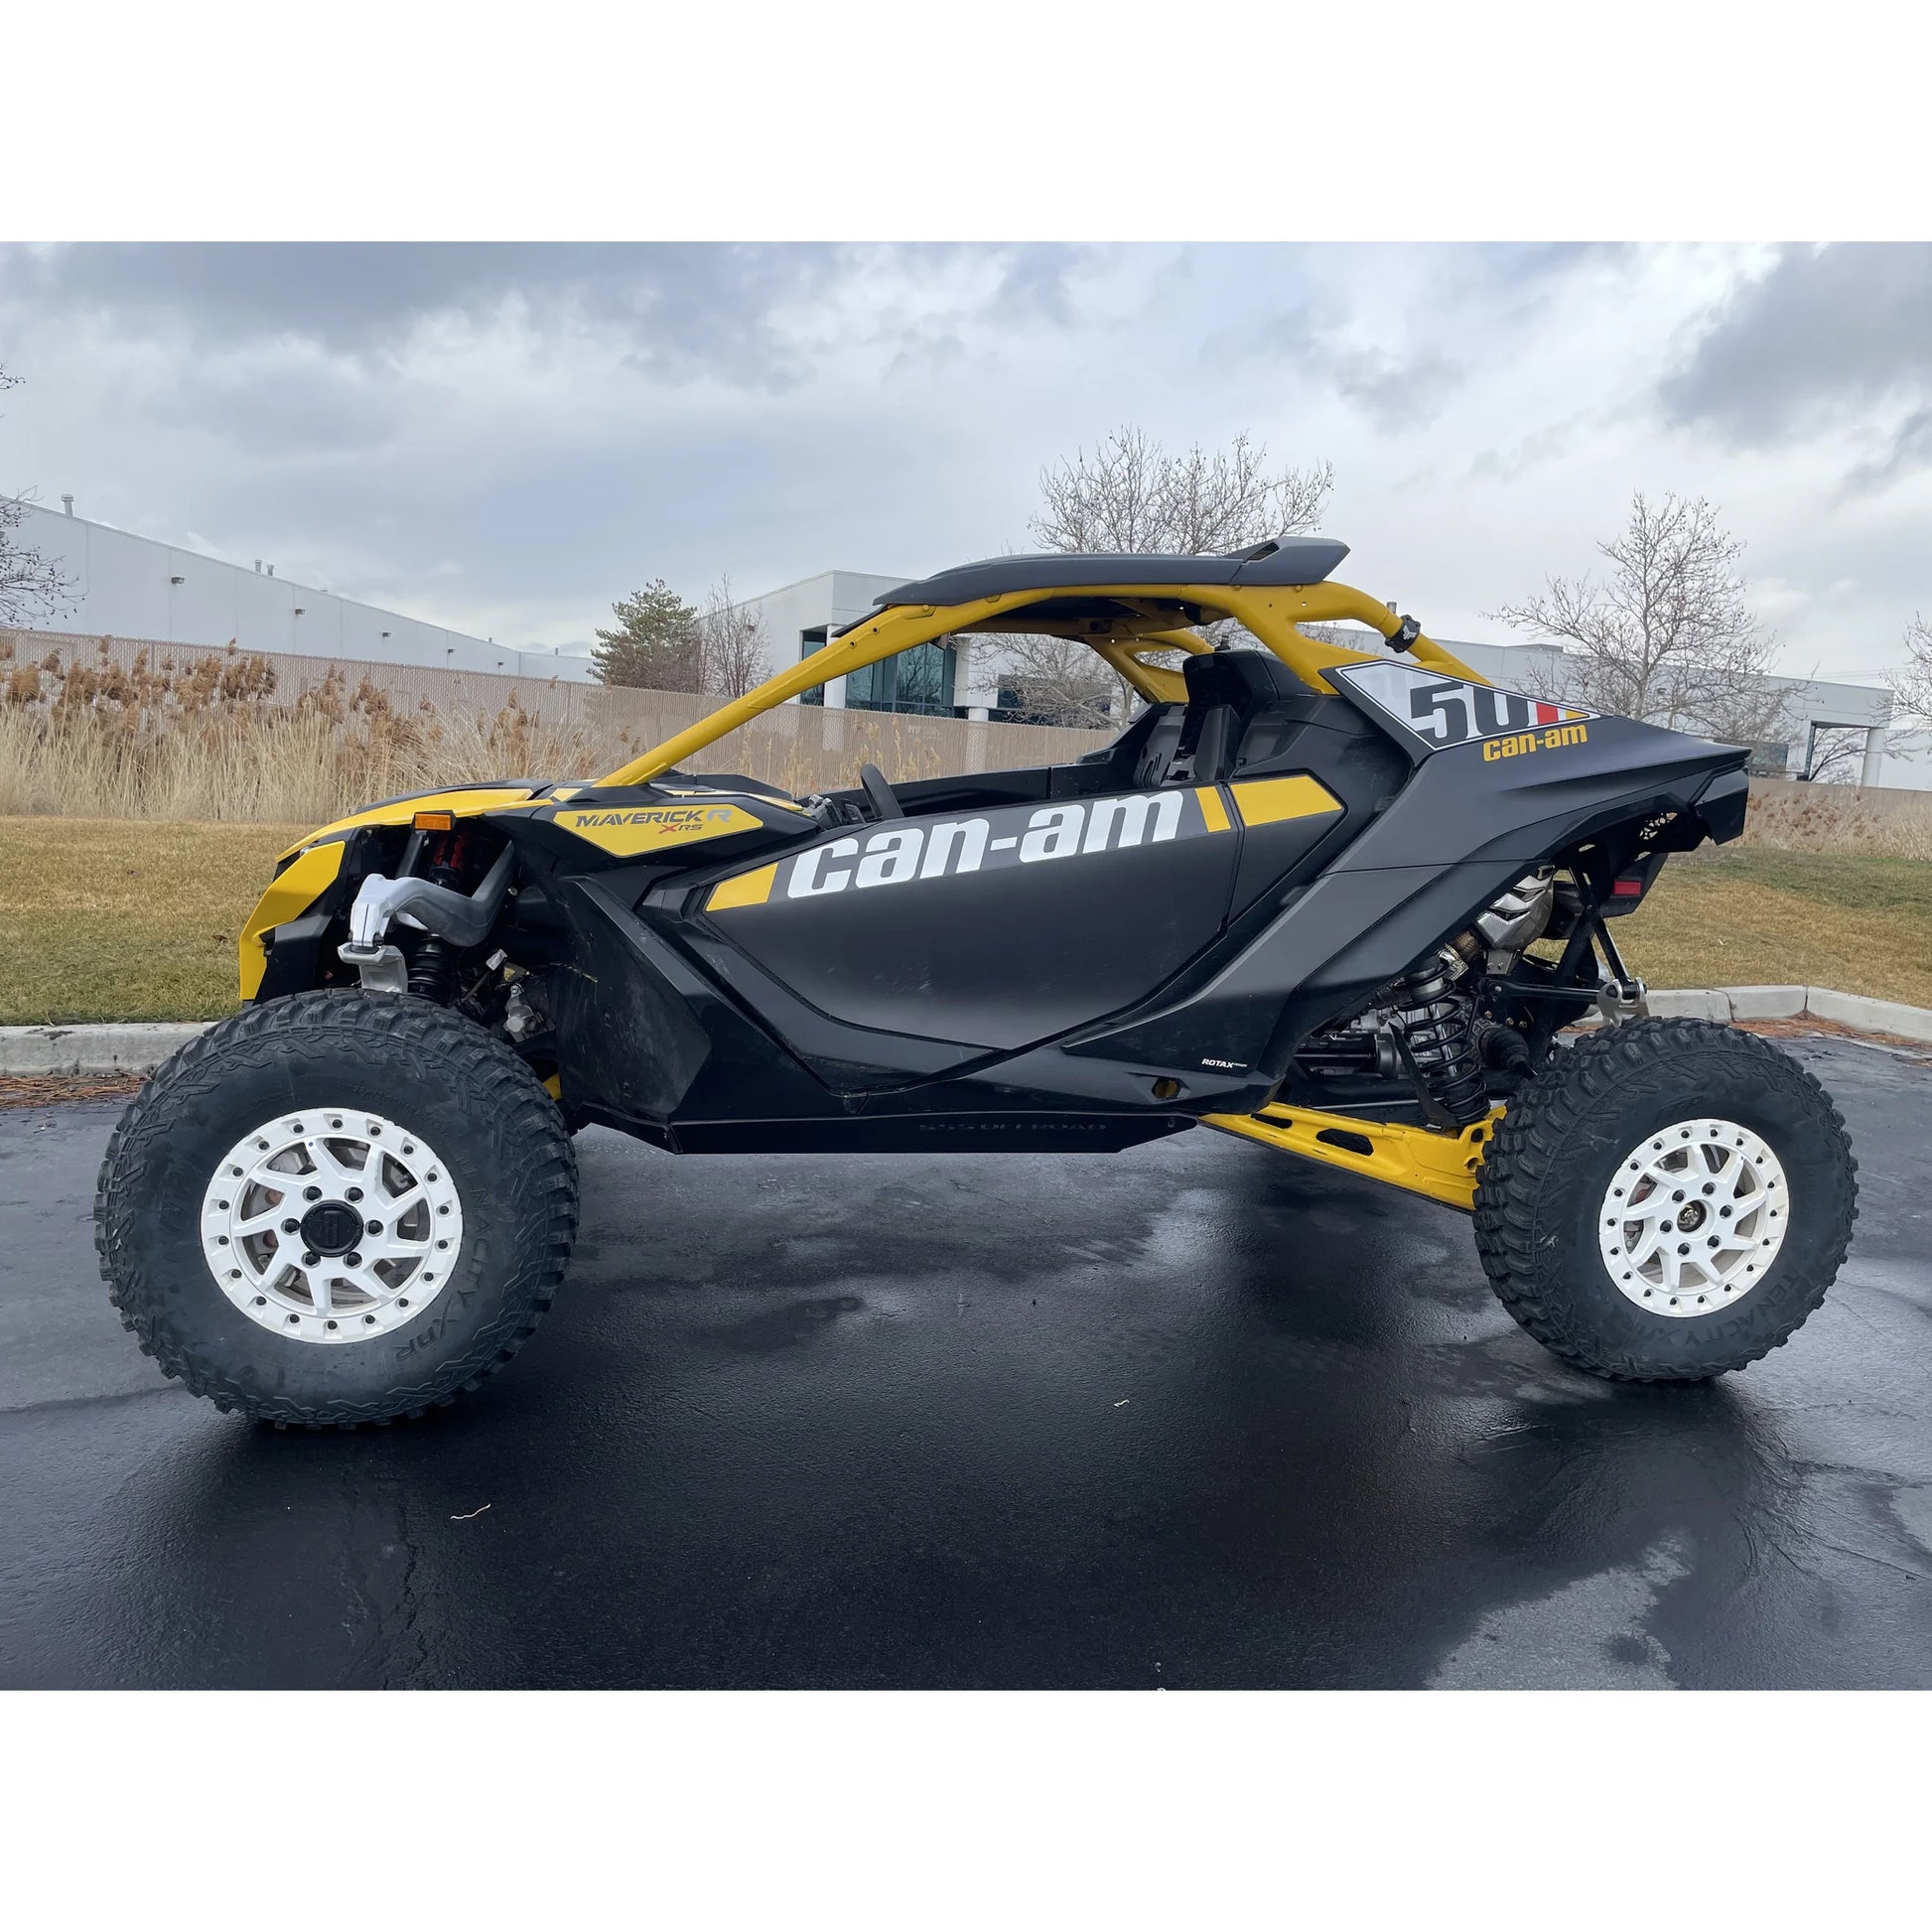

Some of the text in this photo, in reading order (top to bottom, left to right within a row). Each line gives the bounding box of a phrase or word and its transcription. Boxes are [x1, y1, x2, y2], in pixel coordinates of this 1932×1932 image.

[1482, 724, 1588, 761] can-am
[576, 808, 733, 828] MAVERICK R
[658, 823, 704, 835] XRS
[787, 790, 1183, 899] can-am
[1200, 1058, 1233, 1069] ROTAX
